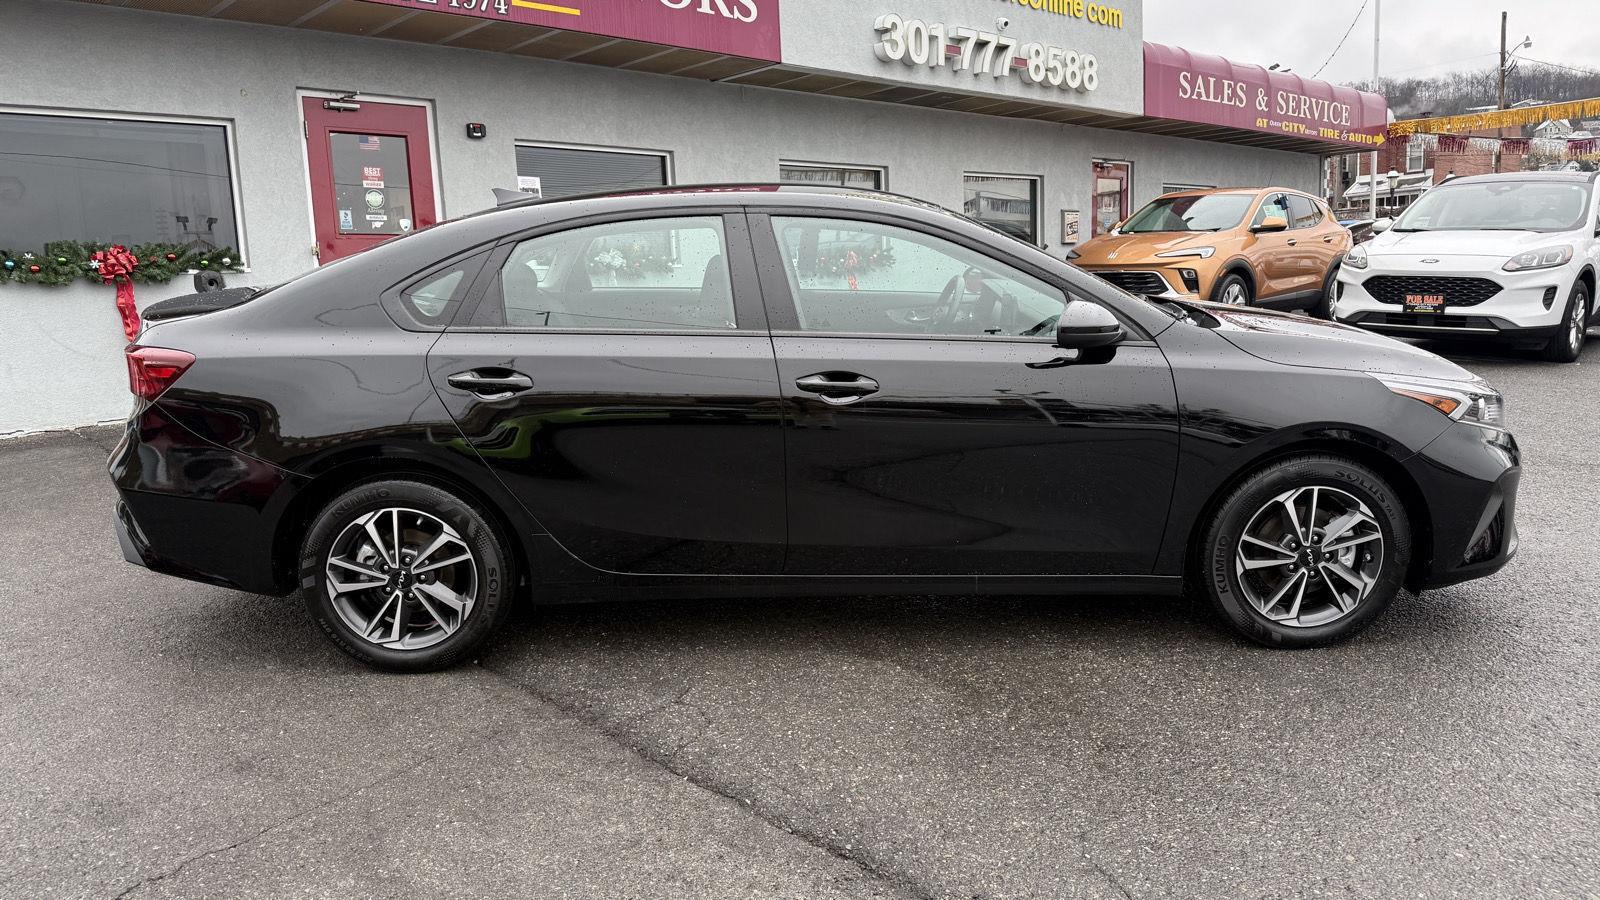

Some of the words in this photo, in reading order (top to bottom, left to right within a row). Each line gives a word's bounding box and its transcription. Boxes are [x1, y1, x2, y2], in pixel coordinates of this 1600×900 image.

[873, 12, 1099, 92] 301-777-8588
[1179, 71, 1247, 108] SALES
[1255, 87, 1269, 112] &
[1276, 90, 1351, 126] SERVICE
[1255, 118, 1268, 128] AT
[1281, 121, 1306, 134] CITY
[1319, 127, 1340, 139] TIRE
[1349, 132, 1373, 144] AUTO
[1406, 294, 1423, 304] FOR
[1424, 295, 1444, 304] SALE
[1215, 535, 1229, 594] KUMHO
